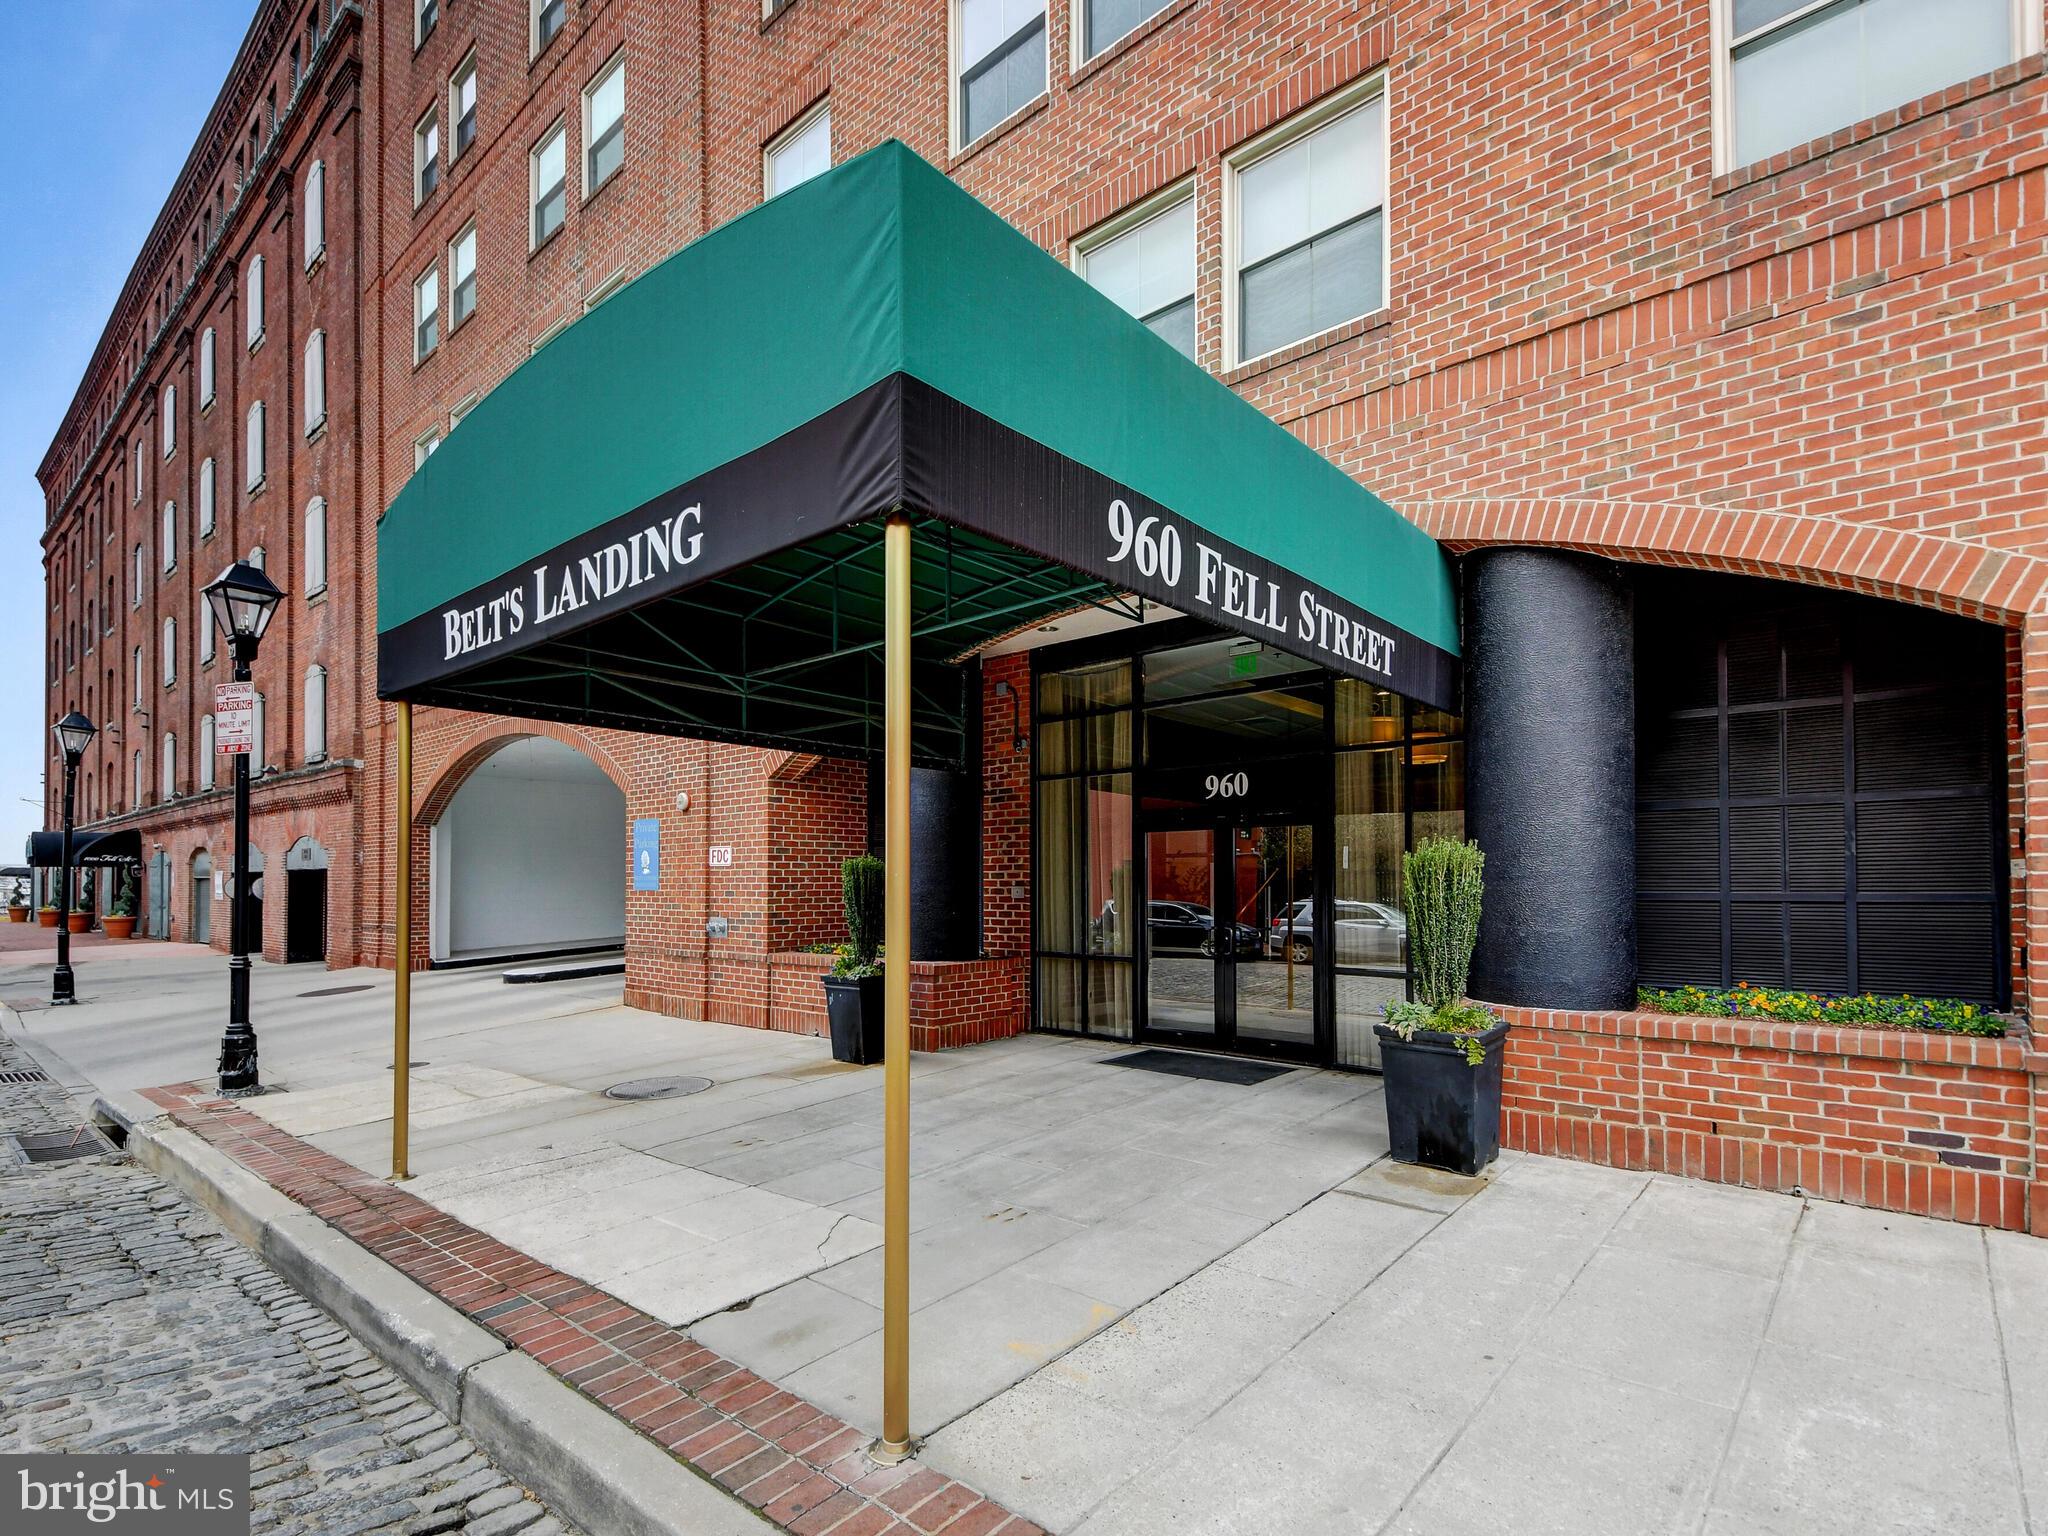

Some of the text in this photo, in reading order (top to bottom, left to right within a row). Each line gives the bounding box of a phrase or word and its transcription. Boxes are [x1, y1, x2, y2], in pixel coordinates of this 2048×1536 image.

[443, 502, 704, 661] BELT'S LANDING
[1106, 499, 1396, 677] 960 FELL STREET
[216, 685, 251, 696] NO PARKING
[217, 700, 252, 711] PARKING
[218, 719, 251, 729] MINUTE LIMIT
[1205, 771, 1249, 800] 960
[711, 849, 729, 863] FDC
